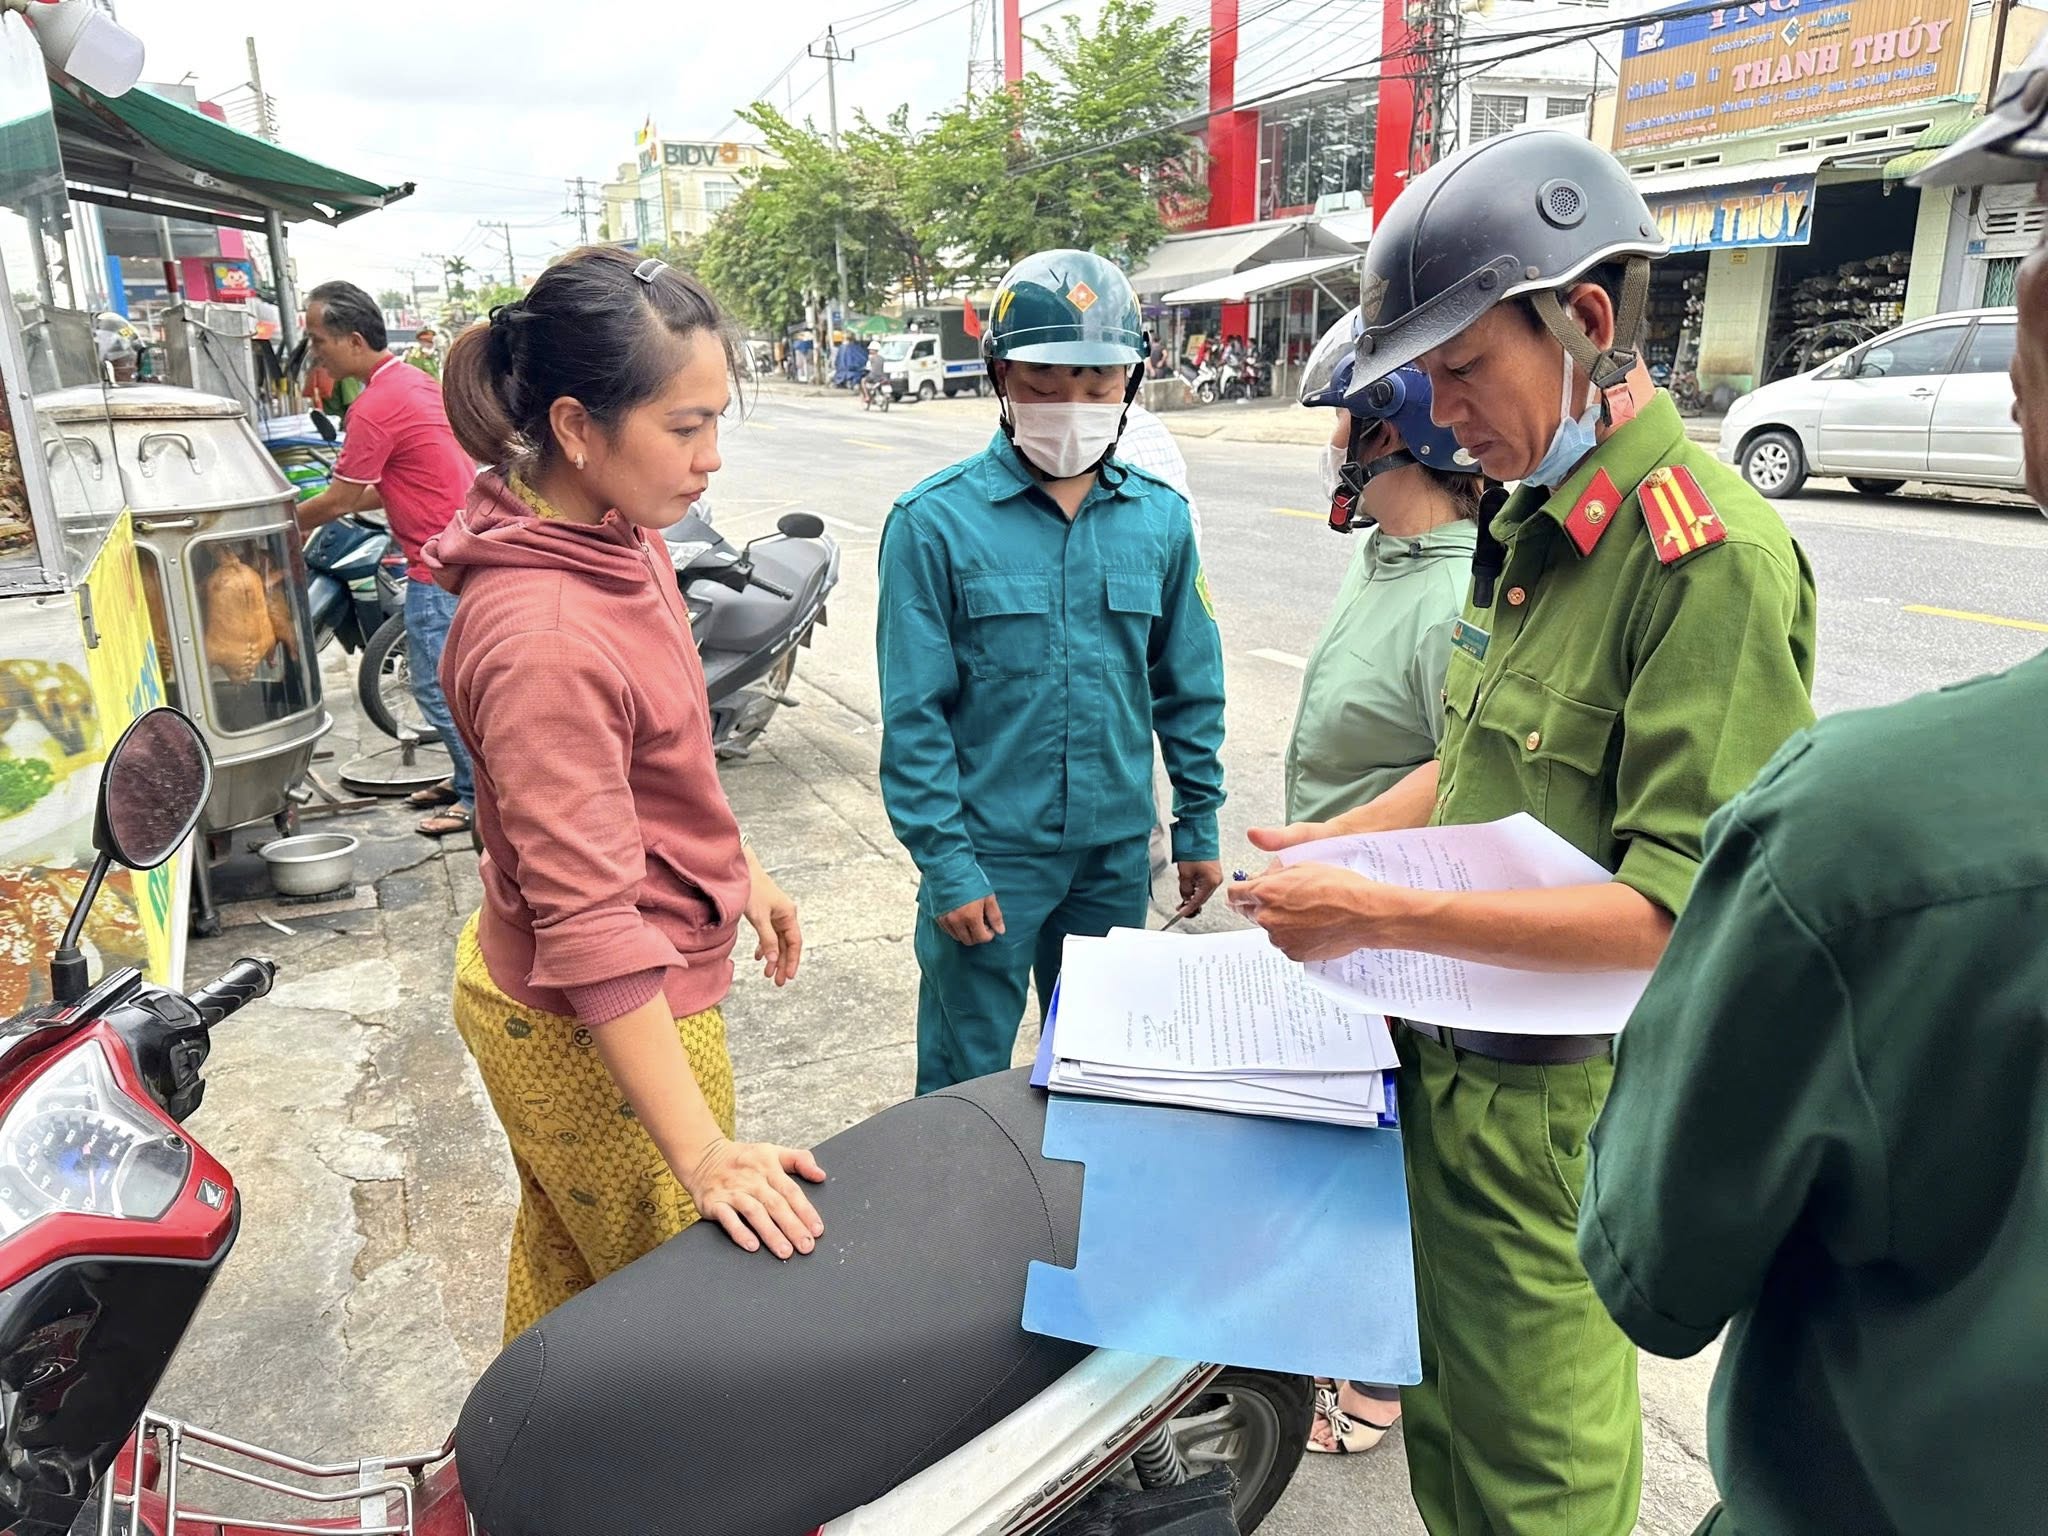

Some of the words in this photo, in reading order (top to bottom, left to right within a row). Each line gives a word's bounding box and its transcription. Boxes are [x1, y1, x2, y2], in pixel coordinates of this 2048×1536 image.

[1732, 43, 1842, 92] THANH
[1851, 16, 1953, 68] THÚY
[663, 143, 720, 166] BIDV
[1651, 201, 1716, 246] ANH
[1721, 181, 1808, 242] THÚY
